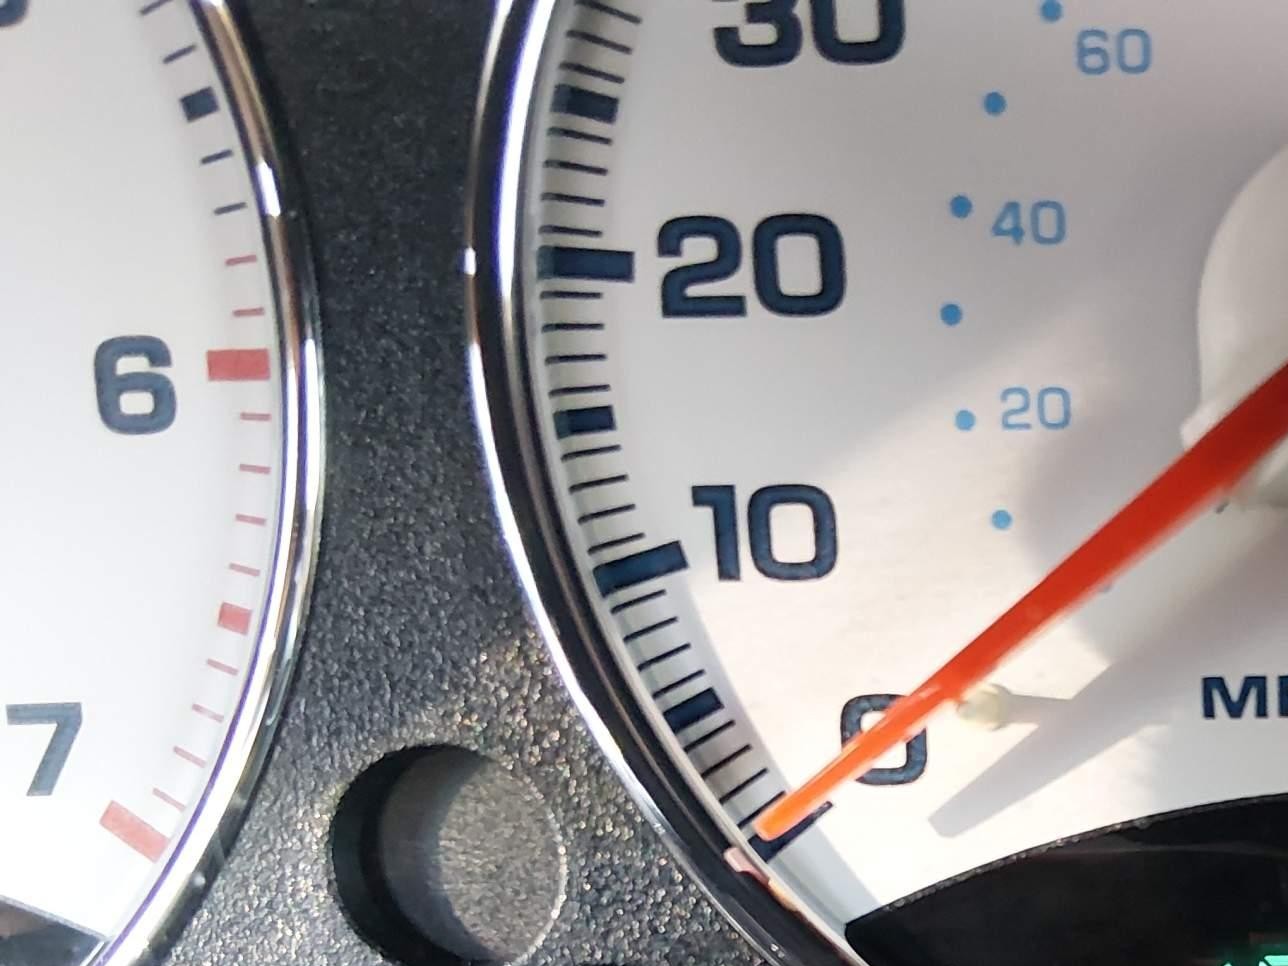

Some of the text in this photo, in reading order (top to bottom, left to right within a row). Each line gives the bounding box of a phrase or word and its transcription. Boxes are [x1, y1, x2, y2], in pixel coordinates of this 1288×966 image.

[713, 0, 906, 67] 30
[1075, 28, 1153, 76] 60
[991, 199, 1067, 246] 40
[656, 212, 847, 319] 20
[93, 334, 177, 436] 6
[1000, 386, 1073, 432] 20
[690, 483, 838, 581] 10
[5, 701, 83, 797] 7
